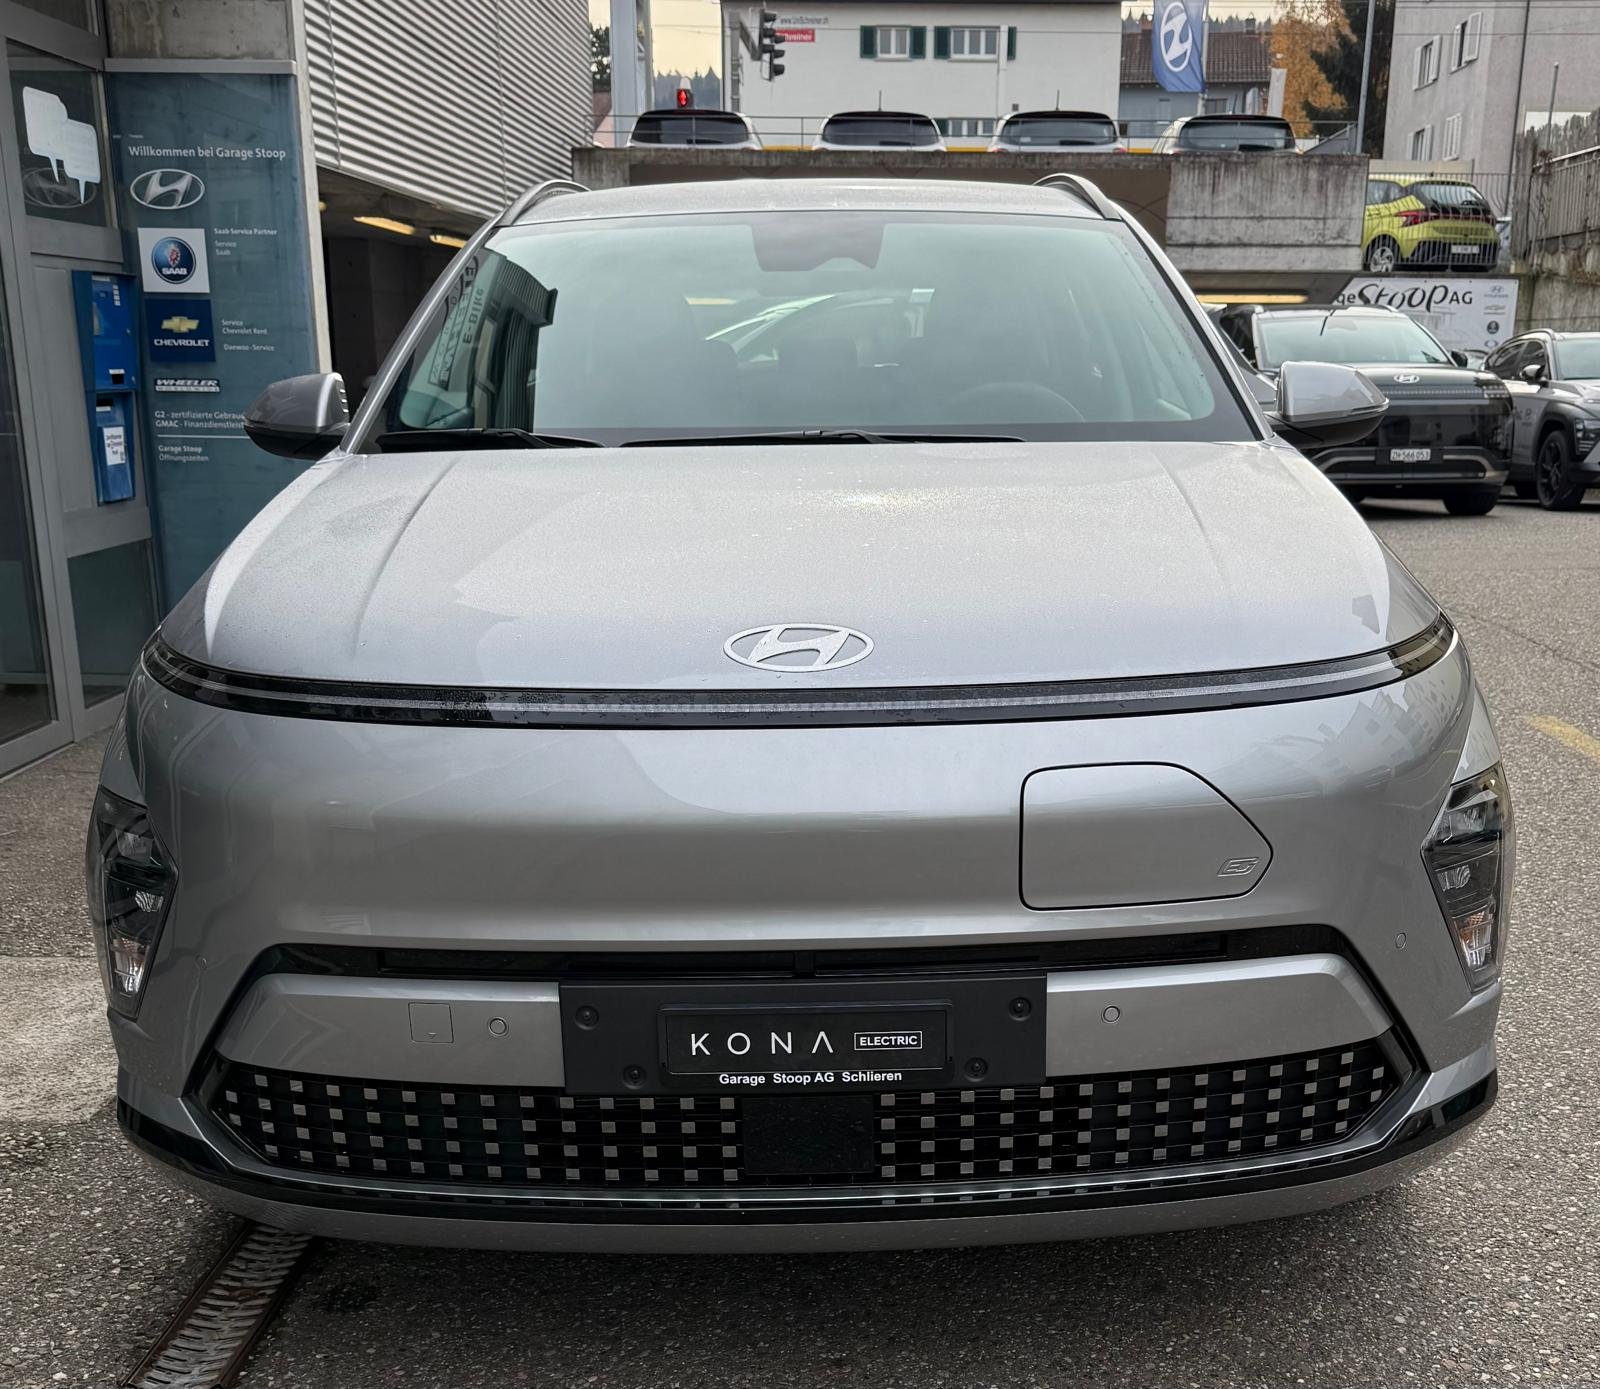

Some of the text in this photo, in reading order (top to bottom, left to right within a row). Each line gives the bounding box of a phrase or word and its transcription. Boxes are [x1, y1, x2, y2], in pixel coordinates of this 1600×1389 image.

[128, 146, 286, 161] Willkommen bei Garage Stoop
[230, 227, 253, 236] Service
[253, 228, 278, 236] Partner
[162, 267, 188, 275] SAAB
[1447, 291, 1473, 305] AG
[153, 338, 210, 347] CHEVROLET
[154, 410, 165, 418] G2
[155, 420, 179, 428] GMAC
[158, 445, 202, 454] Garage Stoop
[691, 1031, 918, 1056] KONA ELECTRIC
[719, 1070, 903, 1087] Garage Stoop AG Schlieren
